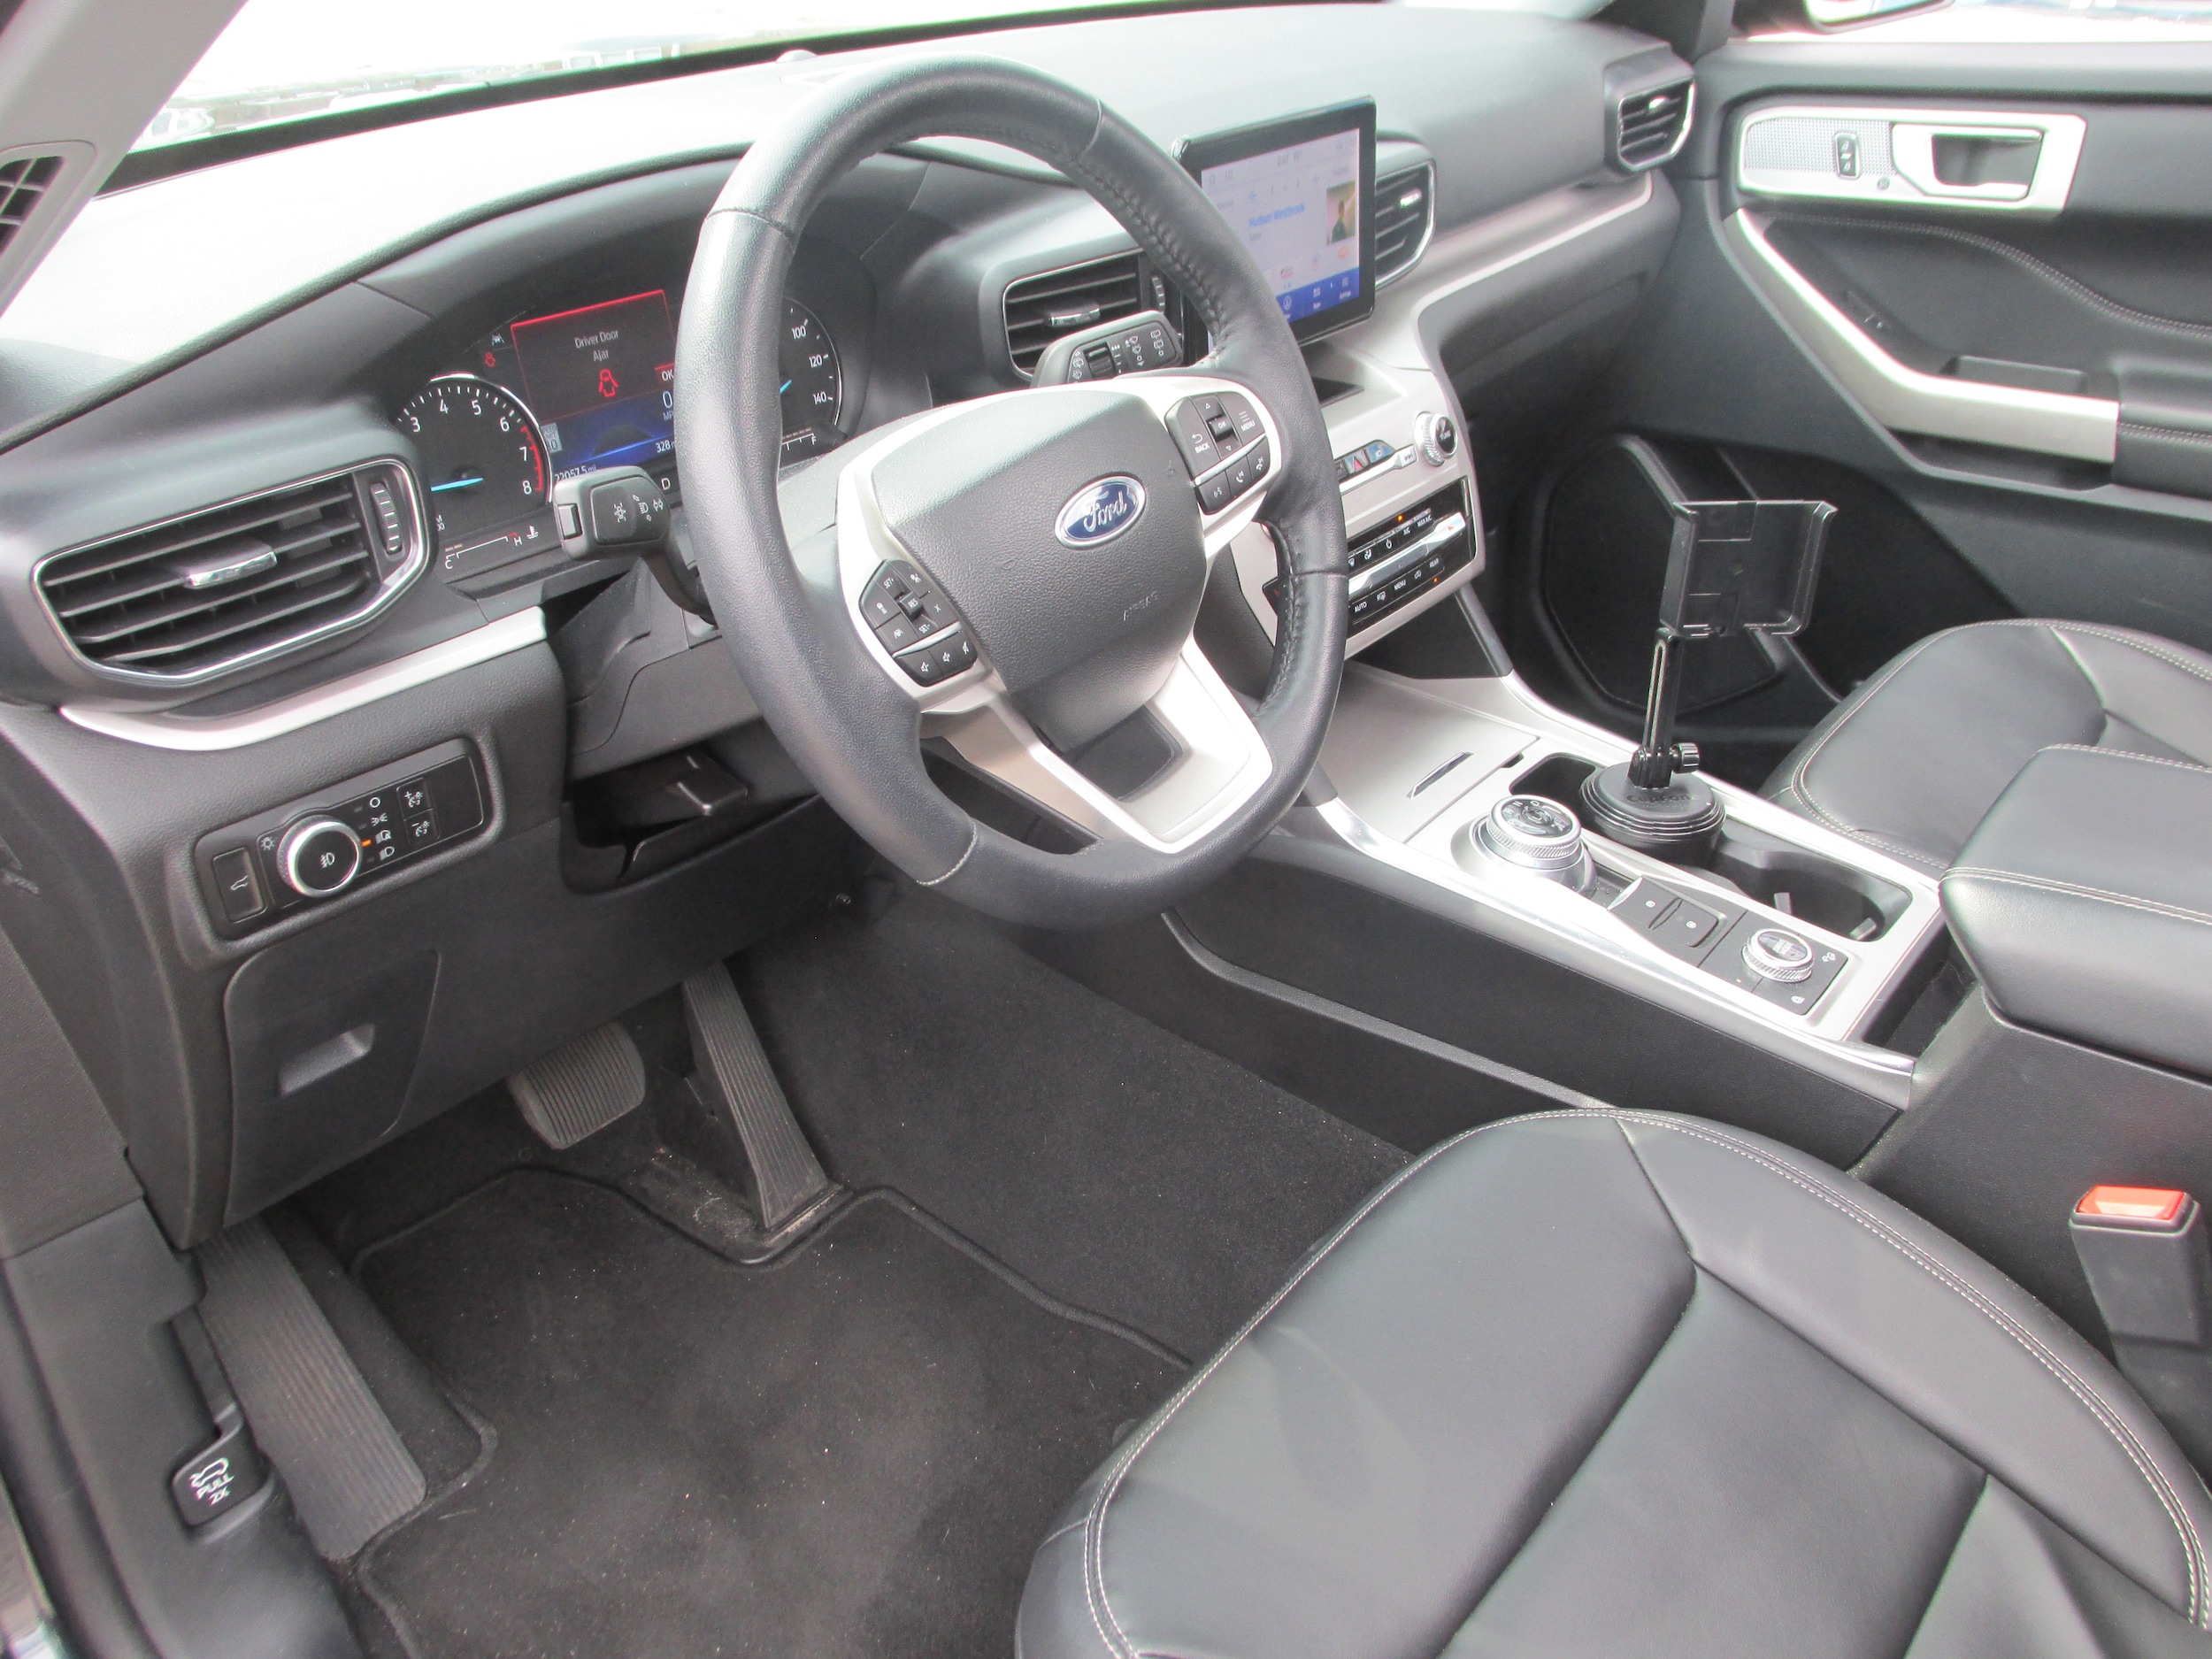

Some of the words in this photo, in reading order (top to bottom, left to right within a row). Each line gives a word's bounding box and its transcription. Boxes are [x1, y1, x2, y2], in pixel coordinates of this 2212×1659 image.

[574, 335, 599, 349] Driver
[599, 330, 618, 342] Door
[792, 325, 806, 340] 100
[593, 349, 609, 362] Ajar
[809, 354, 823, 368] 120
[661, 369, 674, 381] OK
[662, 391, 673, 409] 0
[812, 391, 827, 405] 140
[439, 399, 449, 414] 4
[472, 400, 482, 416] 5
[410, 417, 421, 433] 3
[499, 416, 510, 432] 6
[1217, 420, 1226, 429] OK
[1240, 420, 1256, 432] MENU
[656, 440, 671, 453] 328
[810, 435, 817, 445] F
[519, 446, 528, 462] 7
[1194, 442, 1210, 454] BACK
[555, 465, 588, 481] 220575
[522, 480, 532, 495] 8
[661, 478, 671, 490] D
[1083, 490, 1127, 533] Ford
[513, 536, 523, 546] H
[445, 559, 454, 570] C
[1394, 580, 1406, 590] MENU
[908, 598, 918, 609] RES
[1354, 602, 1367, 612] AUTO
[196, 1474, 234, 1499] PULL
